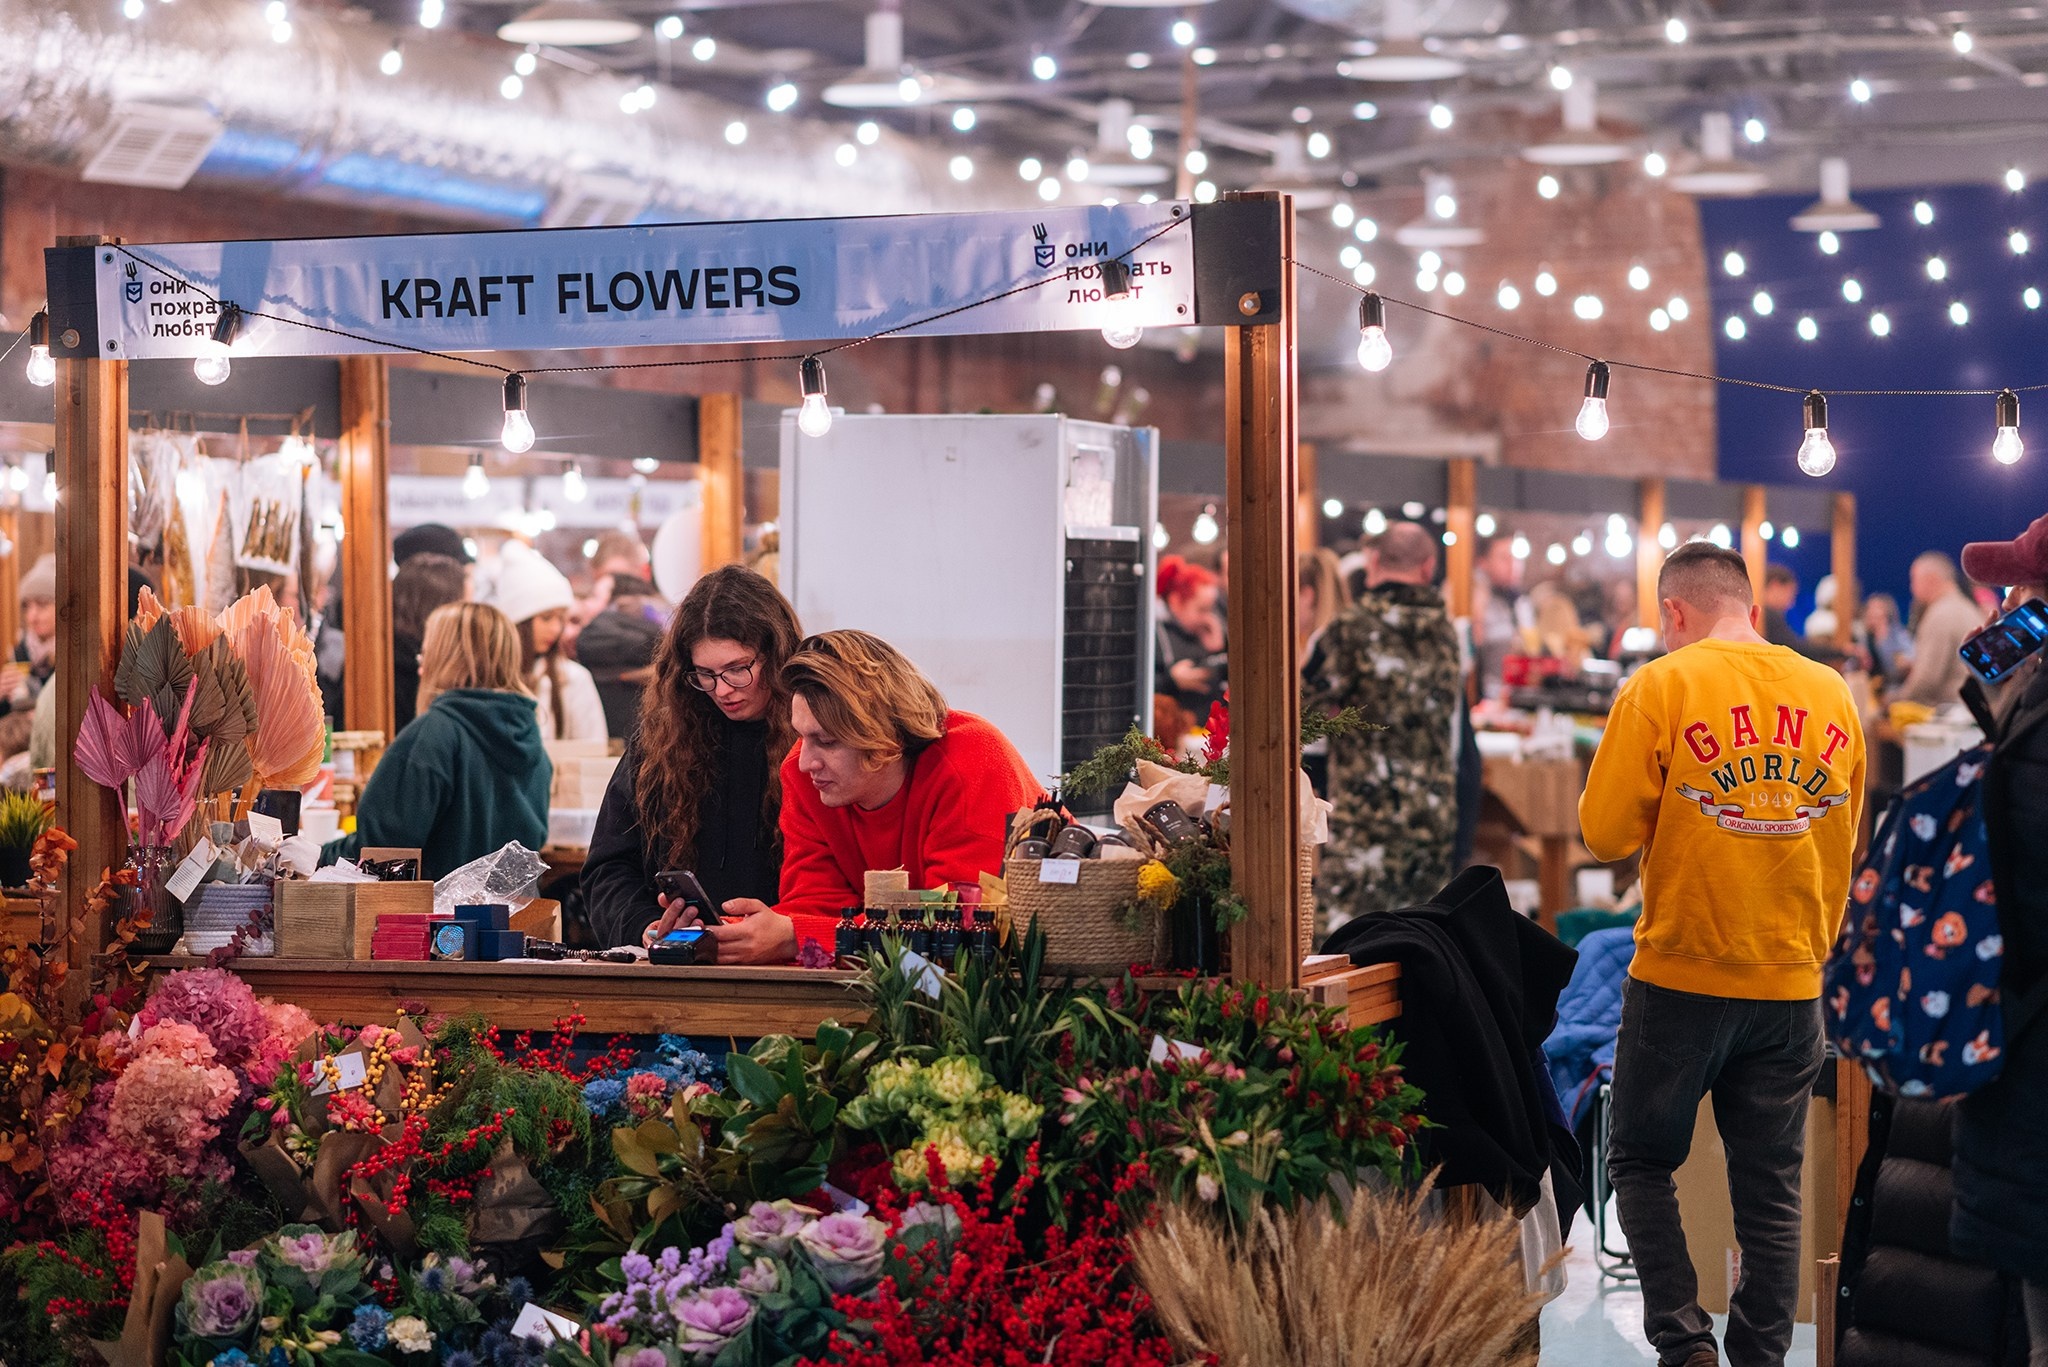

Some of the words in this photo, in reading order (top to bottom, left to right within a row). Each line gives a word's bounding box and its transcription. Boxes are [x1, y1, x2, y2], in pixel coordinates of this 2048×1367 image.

[1064, 241, 1109, 258] они
[149, 280, 187, 295] они
[380, 274, 534, 319] KRAFT
[557, 265, 801, 315] FLOWERS
[1067, 285, 1144, 304] лют
[1683, 704, 1850, 765] GANT
[1710, 753, 1829, 797] WORLD
[1748, 791, 1793, 809] 1949
[1724, 817, 1764, 832] ORIGINAL
